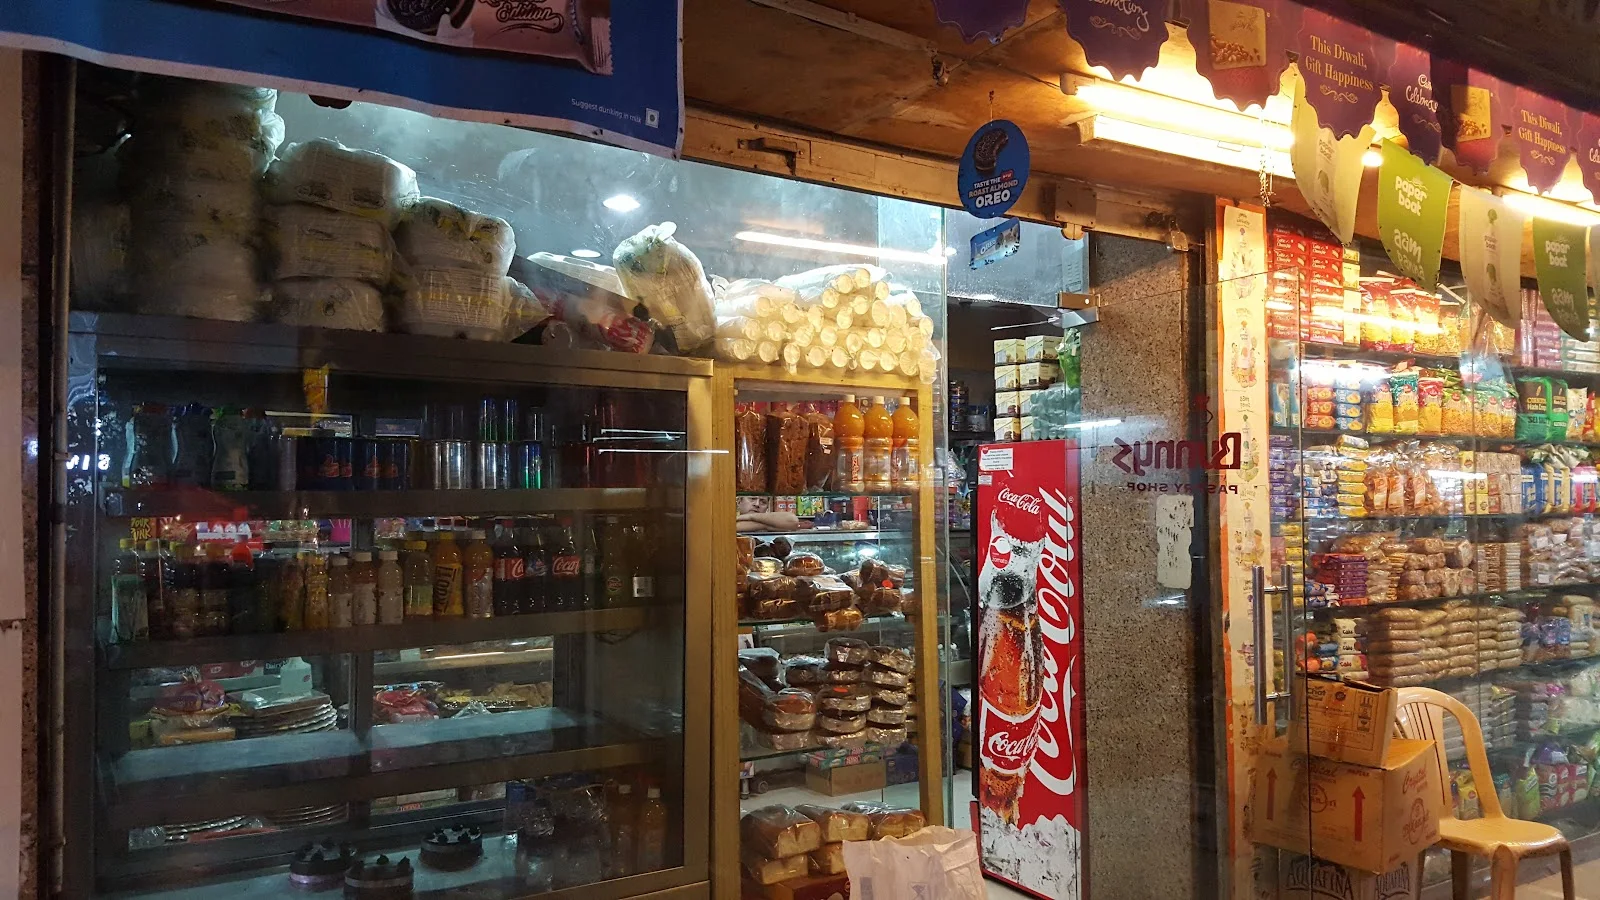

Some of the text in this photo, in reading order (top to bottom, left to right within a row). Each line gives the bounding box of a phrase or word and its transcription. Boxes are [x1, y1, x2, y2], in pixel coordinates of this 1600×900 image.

[496, 2, 560, 23] Edition
[1310, 35, 1367, 71] This Diwali,
[1305, 55, 1374, 92] Gift Happiness
[571, 98, 598, 111] Suggest
[598, 106, 623, 119] dunking
[629, 115, 642, 125] milk
[1521, 109, 1562, 137] This Diwali,
[1518, 126, 1532, 142] Gift
[1534, 131, 1566, 154] Happiness
[968, 179, 1018, 198] ROAST ALMOND
[974, 179, 989, 189] TASTE
[1395, 175, 1427, 202] paper
[975, 189, 1011, 208] OREO
[1398, 190, 1421, 216] boat
[1394, 229, 1422, 263] aam
[1545, 240, 1570, 254] paper
[1549, 252, 1568, 268] boat
